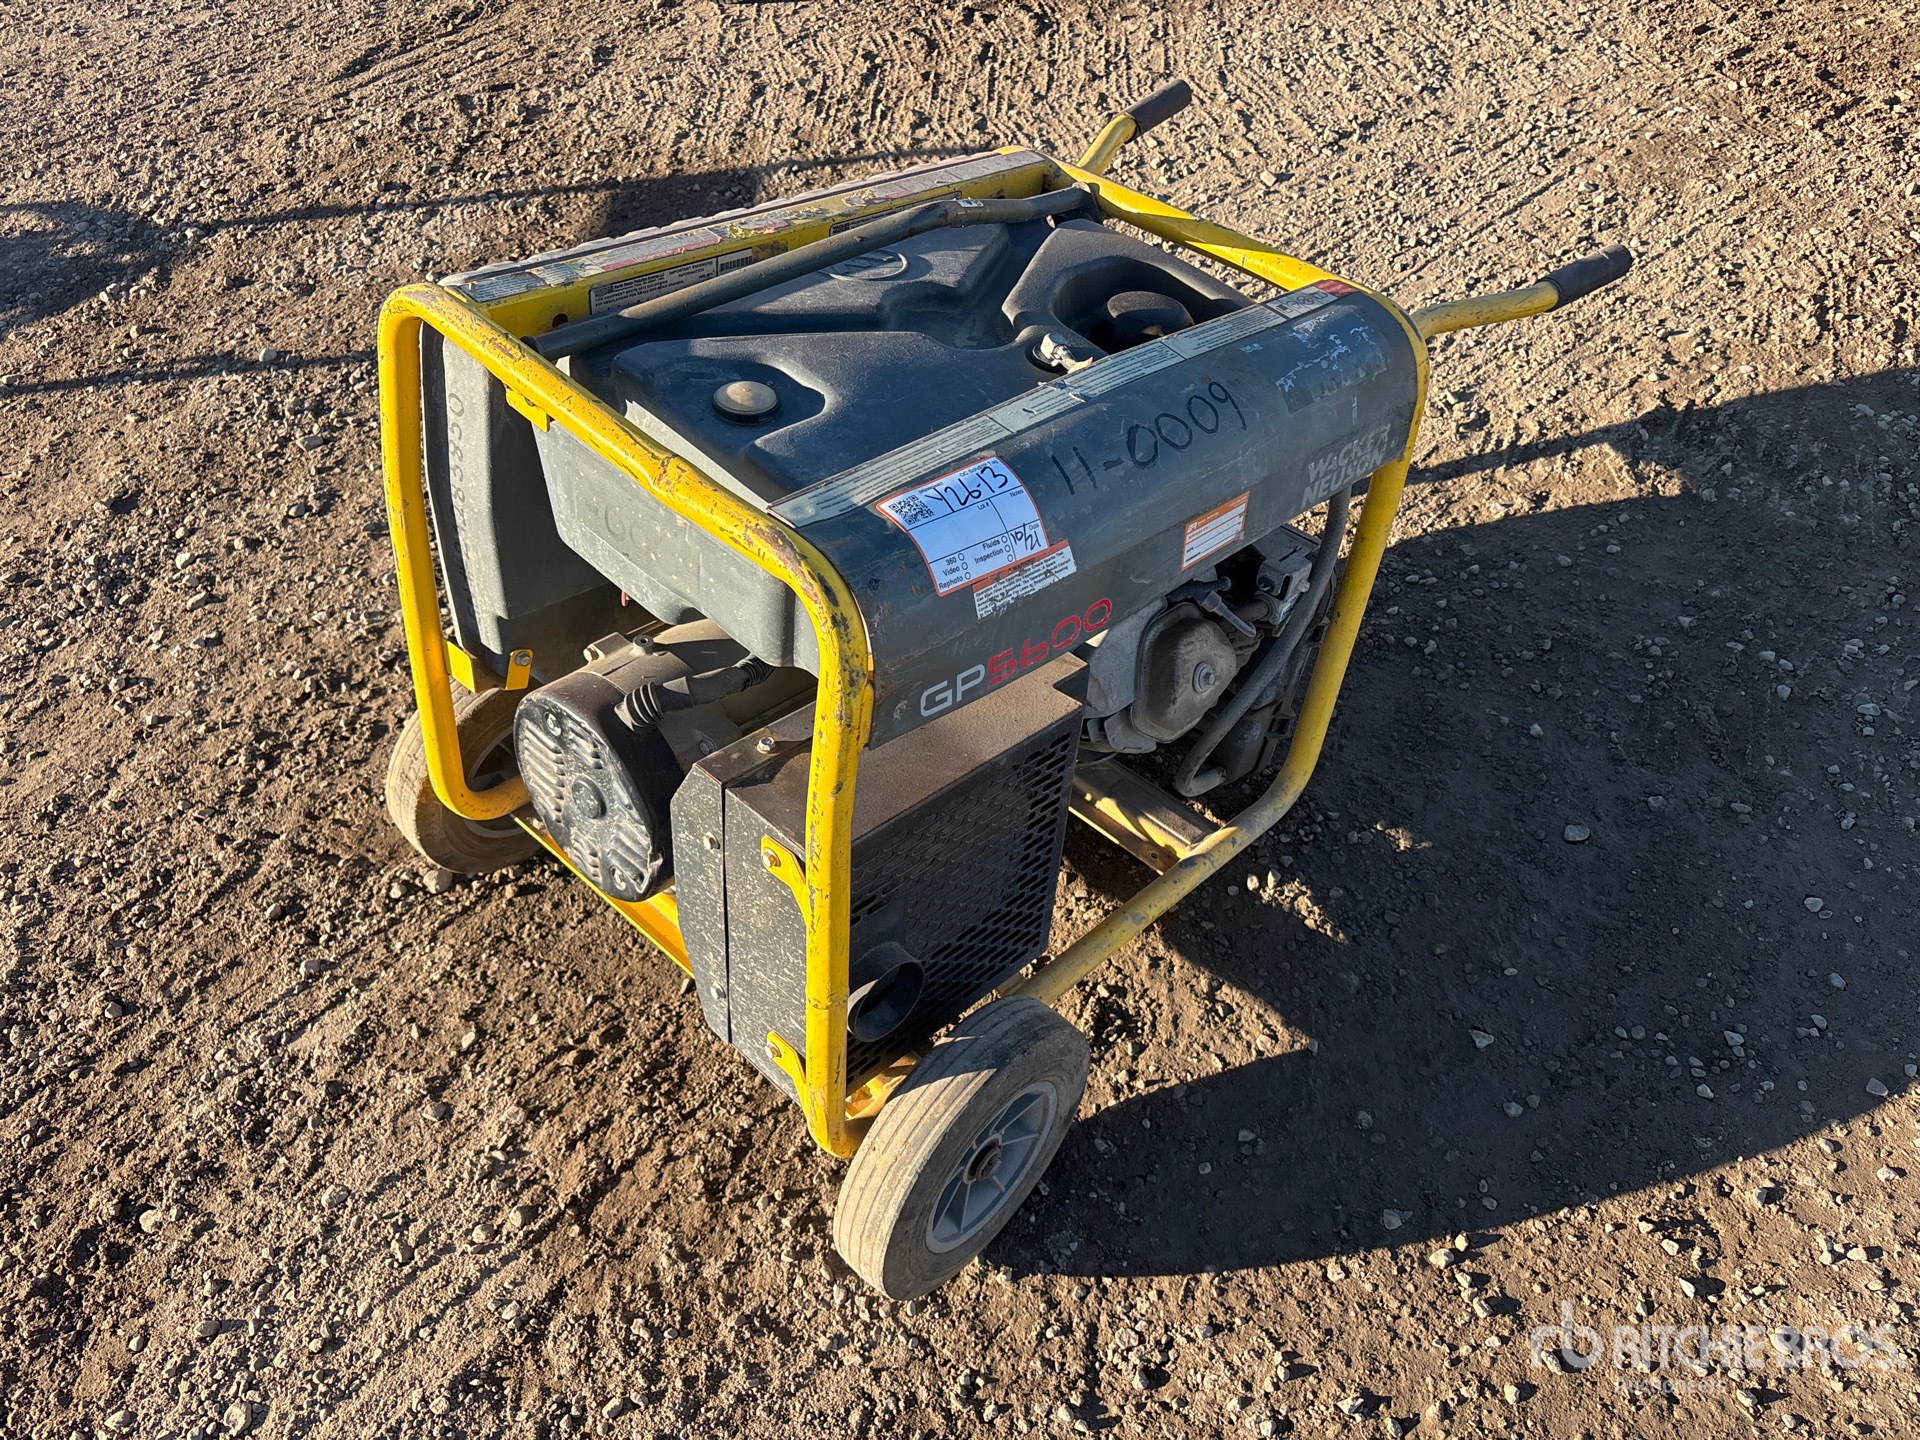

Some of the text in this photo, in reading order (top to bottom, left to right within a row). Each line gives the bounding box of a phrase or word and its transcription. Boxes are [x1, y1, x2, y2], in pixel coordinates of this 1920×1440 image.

[1308, 423, 1392, 484] WACKER
[1301, 445, 1387, 510] NEUSON
[1009, 489, 1024, 498] Notes
[976, 502, 986, 511] Lot
[1028, 523, 1040, 531] Date
[982, 539, 1001, 551] Fluids
[945, 556, 957, 566] 360
[974, 548, 1004, 565] Inspection
[942, 565, 960, 577] Video
[938, 575, 964, 591] Rephoto
[920, 598, 1113, 717] GP5600
